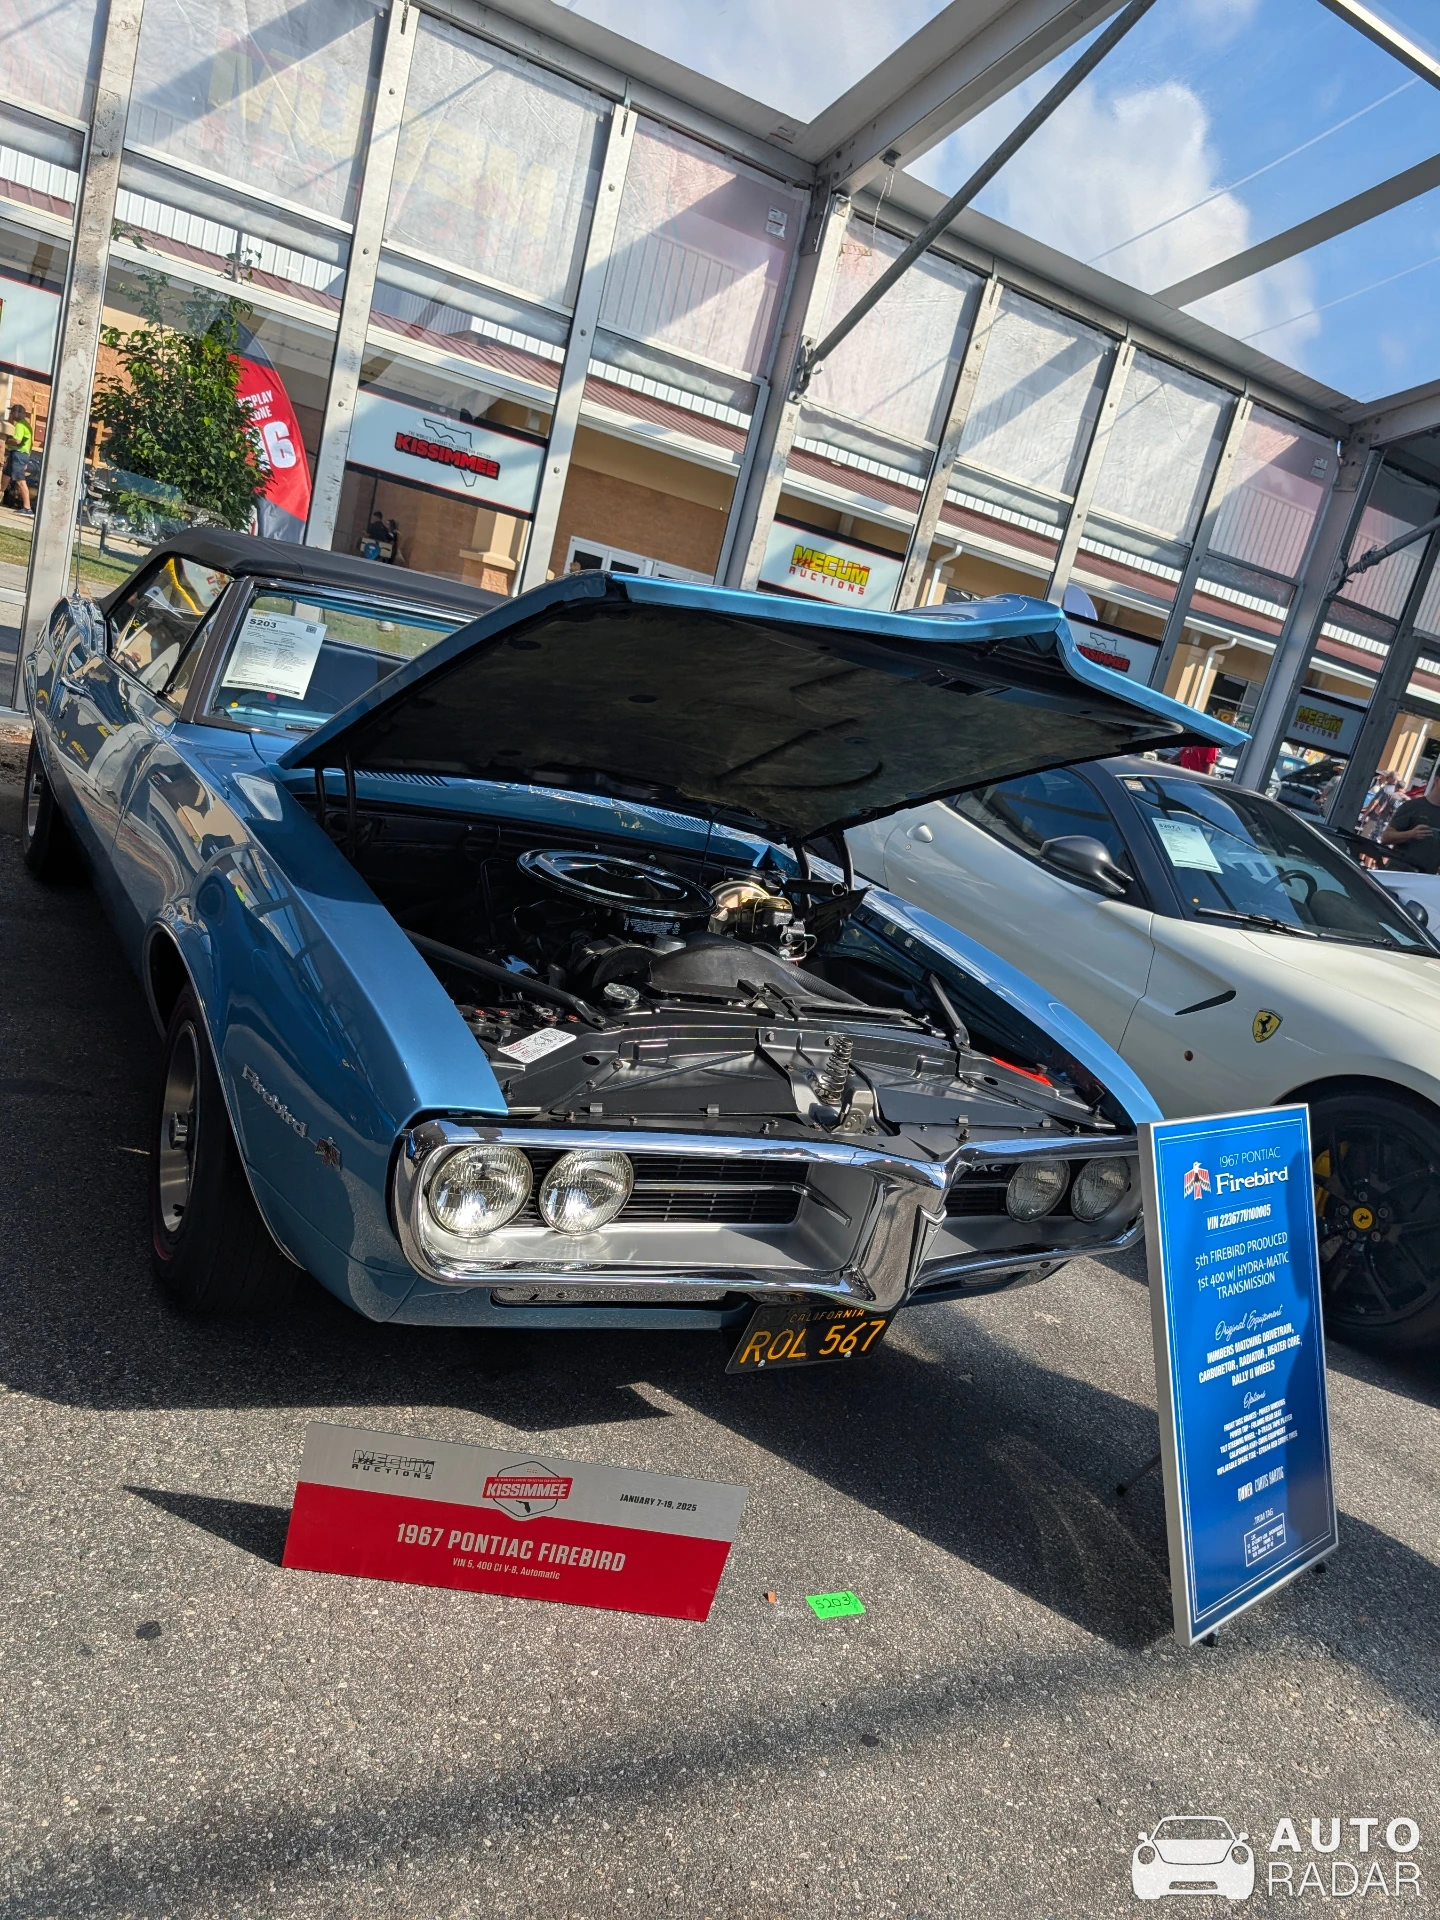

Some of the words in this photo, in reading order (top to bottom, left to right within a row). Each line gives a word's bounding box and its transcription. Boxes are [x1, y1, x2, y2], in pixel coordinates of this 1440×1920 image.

[395, 432, 500, 481] KISSIMMEE
[791, 544, 871, 587] MECUM
[788, 566, 864, 595] AUCTIONS
[249, 618, 276, 628] S203
[1293, 721, 1338, 740] AUCTIONS
[1295, 705, 1344, 732] MECUM
[1220, 1154, 1240, 1168] 1967
[1242, 1146, 1281, 1164] PONTIAC
[1215, 1166, 1289, 1195] Firebird
[1207, 1215, 1218, 1230] VIN
[1195, 1252, 1208, 1270] 5th
[1210, 1243, 1246, 1264] FIREBIRD
[1247, 1232, 1288, 1253] PRODUCED
[1198, 1276, 1208, 1292] 1st
[1210, 1272, 1224, 1287] 400
[1238, 1251, 1289, 1277] HYDRA-MATIC
[1216, 1271, 1276, 1299] TRANSMISSION
[790, 1309, 865, 1323] CALIFORNIA
[1215, 1313, 1248, 1342] Original
[1247, 1304, 1283, 1331] Equipment
[740, 1328, 806, 1364] ROL
[819, 1320, 886, 1354] 567
[1207, 1344, 1234, 1364] NUMBERS
[1234, 1334, 1262, 1353] MATCHING
[1262, 1322, 1294, 1342] DRIVETRAIN,
[1199, 1360, 1238, 1384] CARBURETOR,
[1267, 1340, 1286, 1356] HEATER
[1232, 1370, 1249, 1386] RALLY
[1254, 1360, 1276, 1377] WHEELS
[352, 1463, 432, 1480] AUCTIONS
[353, 1450, 436, 1475] MECUM
[486, 1483, 568, 1497] KISSIMMEE
[620, 1494, 656, 1506] JANUARY
[656, 1498, 674, 1510] 7-19,
[676, 1502, 698, 1512] 2025
[397, 1522, 444, 1547] 1967
[448, 1530, 534, 1560] PONTIAC
[538, 1542, 626, 1572] FIREBIRD
[452, 1558, 466, 1567] VIN
[467, 1560, 474, 1570] 5,
[476, 1560, 492, 1572] 400
[494, 1562, 502, 1572] CI
[504, 1564, 518, 1575] V-8,
[520, 1566, 560, 1580] Automatic
[816, 1596, 851, 1608] S203
